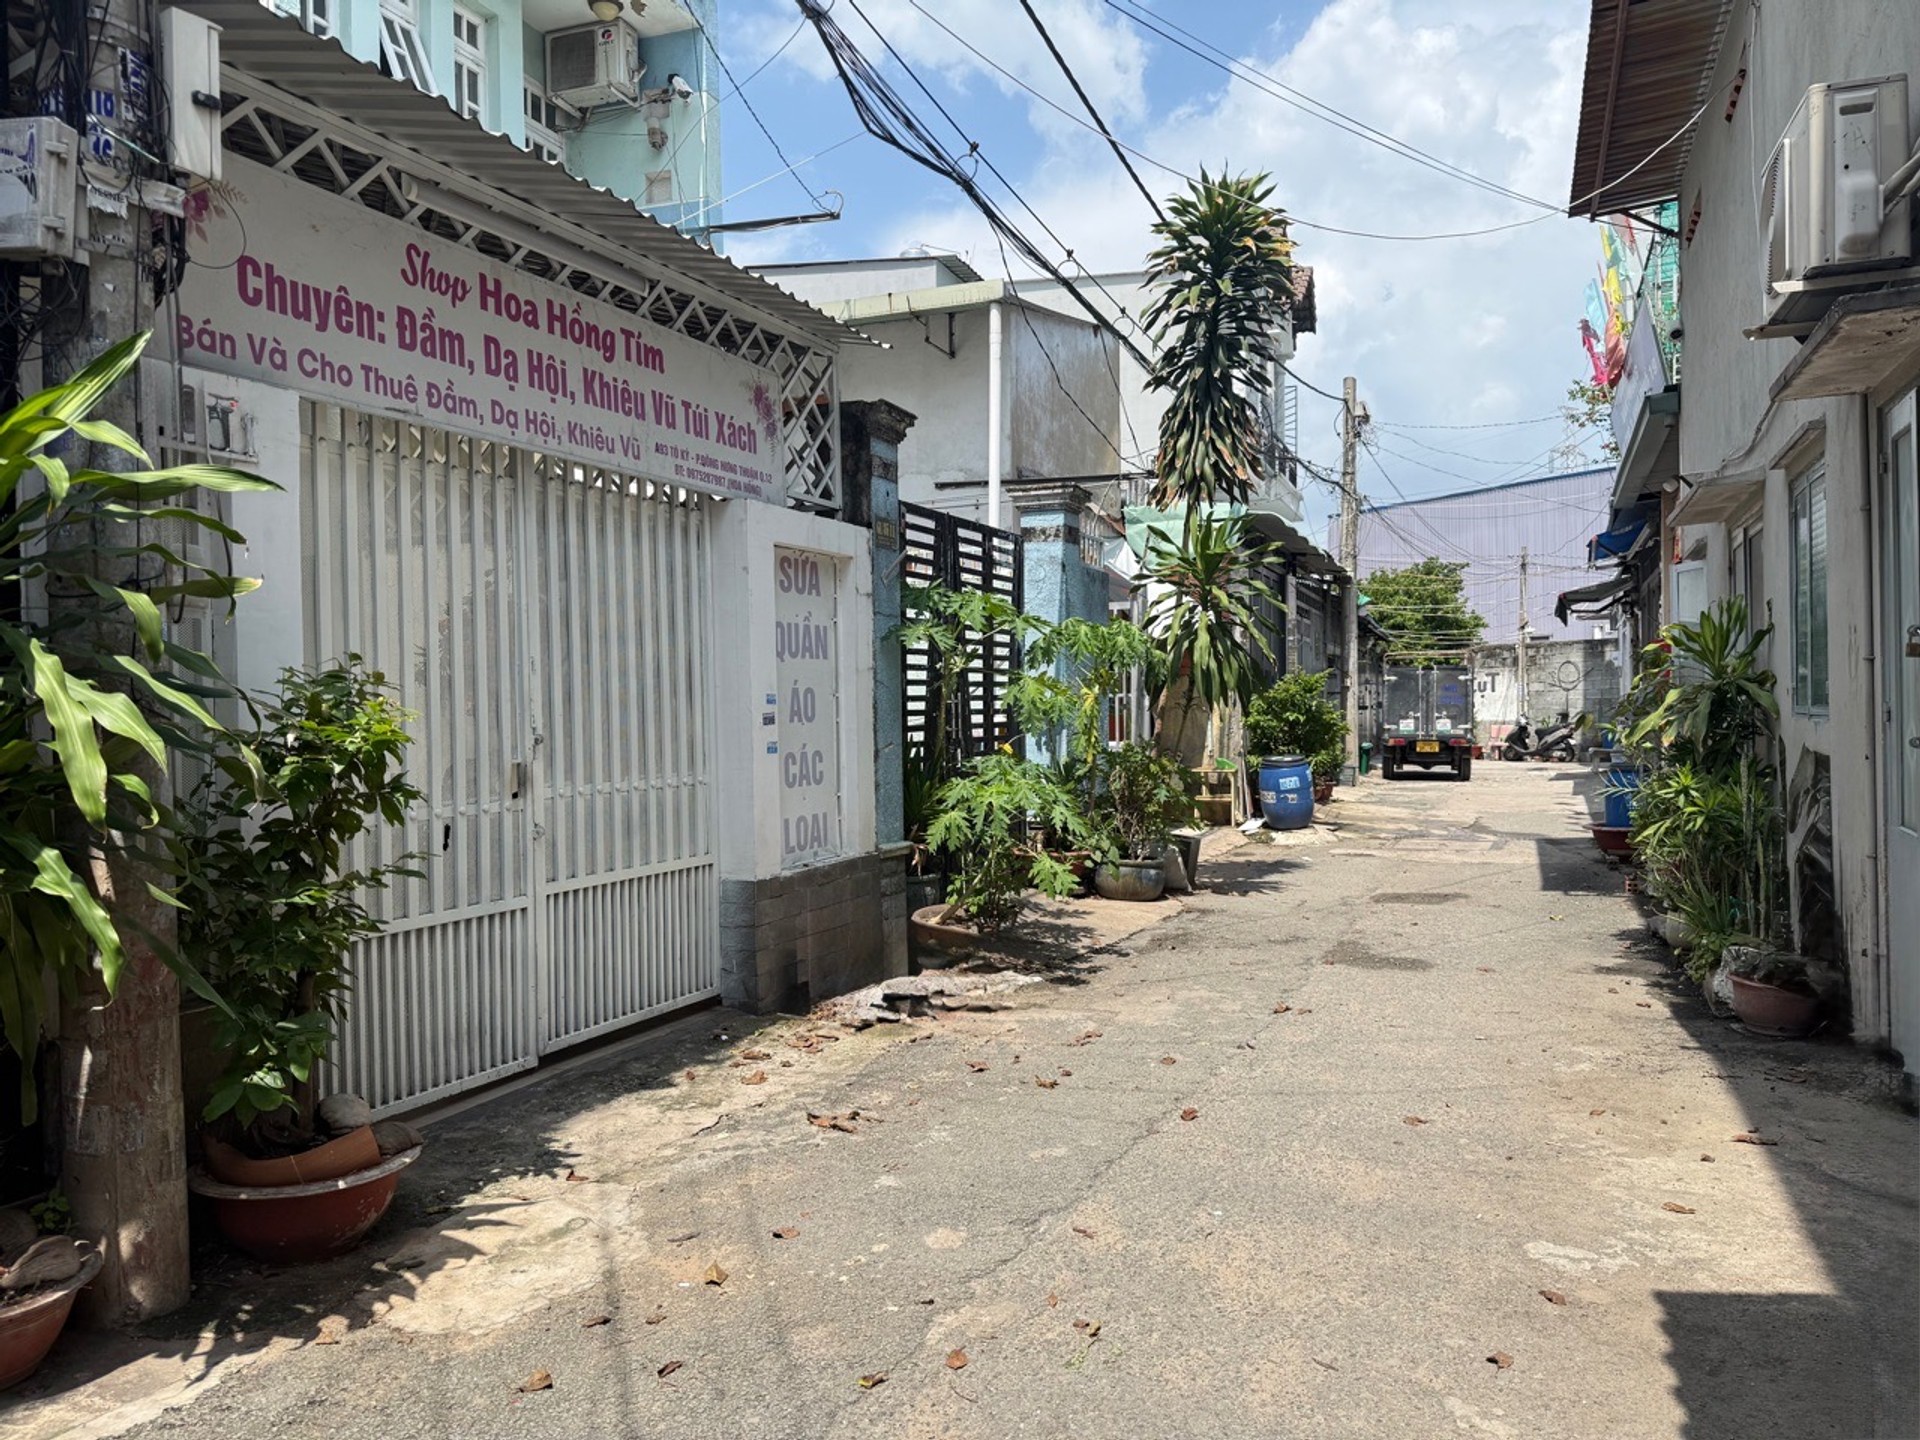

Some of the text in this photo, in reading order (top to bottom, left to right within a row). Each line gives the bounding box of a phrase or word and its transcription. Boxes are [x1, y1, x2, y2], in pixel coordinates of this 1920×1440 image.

[400, 243, 665, 374] Shop Hoa Hồng Tím
[236, 254, 758, 455] Chuyên: Đầm, Dạ Hội, Khiêu Vũ Túi Xách
[180, 315, 642, 461] Bán Và Cho Thuê Đầm, Dạ Hội, Khiêu Vũ
[775, 610, 828, 662] QUẦN
[789, 679, 816, 724] ÁO
[784, 744, 824, 788] CÁC
[783, 812, 828, 857] LOẠI
